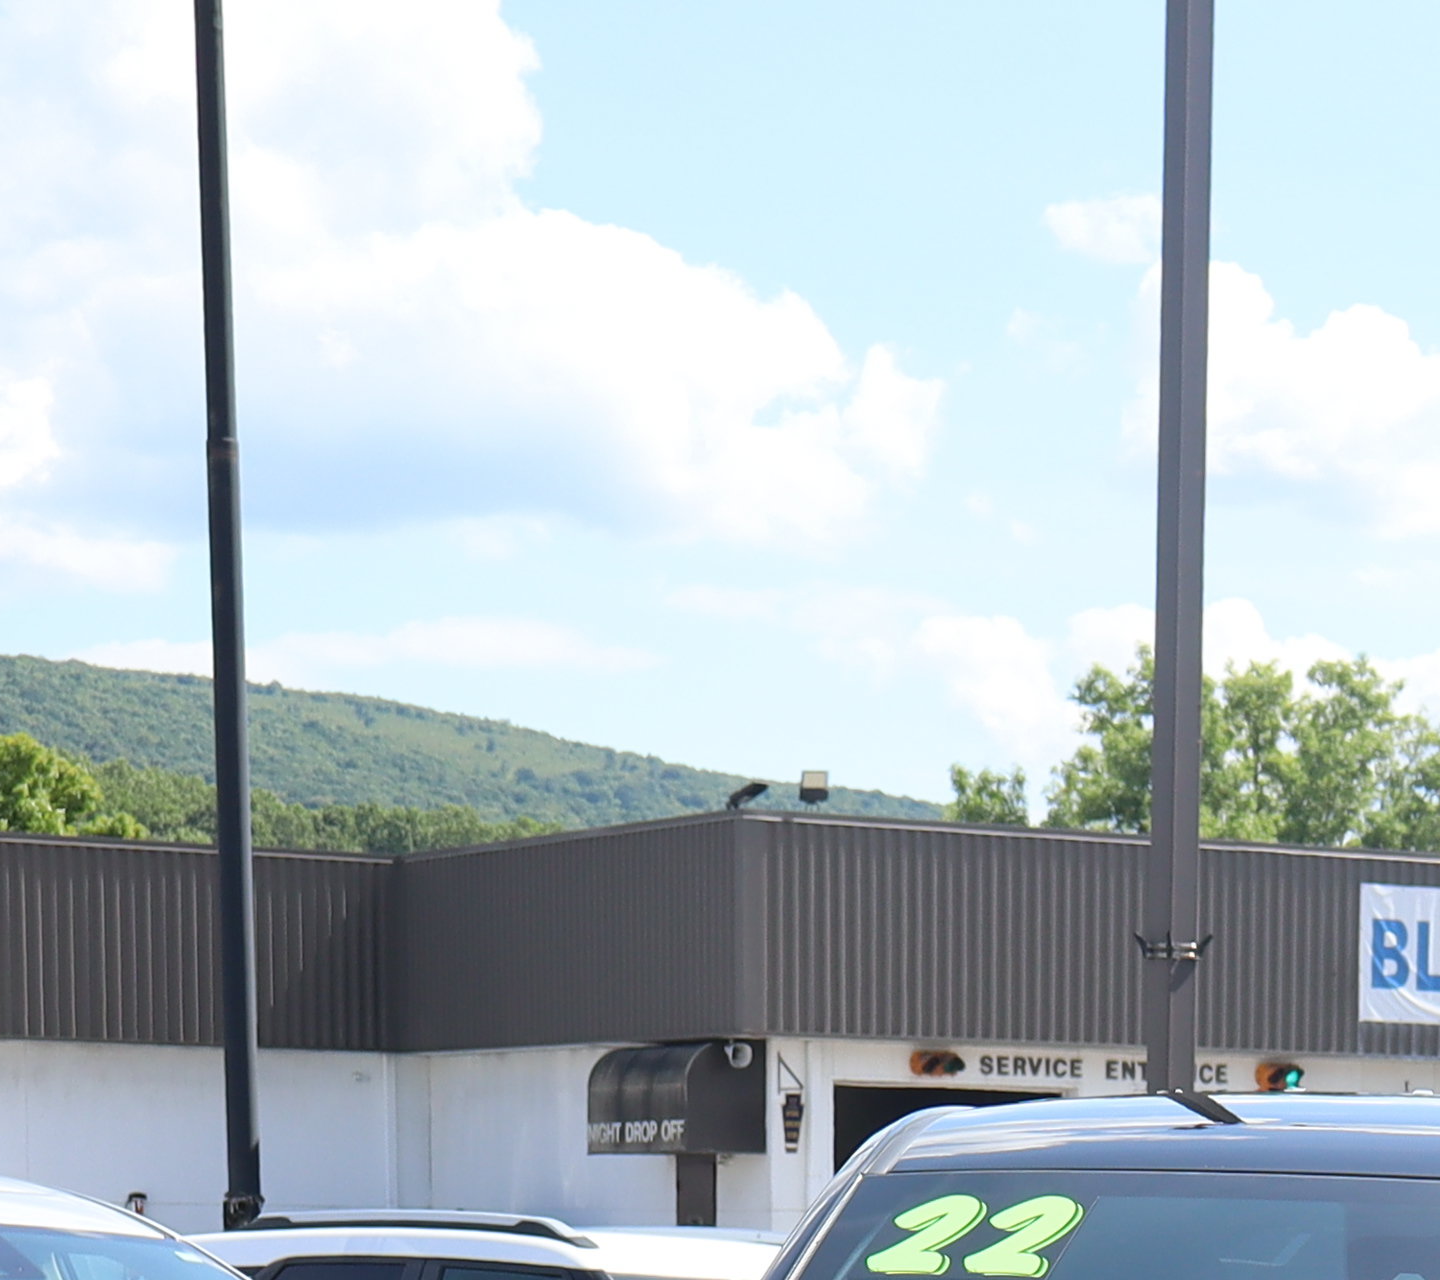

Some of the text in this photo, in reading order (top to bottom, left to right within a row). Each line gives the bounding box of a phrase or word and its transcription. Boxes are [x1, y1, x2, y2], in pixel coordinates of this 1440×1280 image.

[979, 1055, 1228, 1084] SERVICE ENTCE
[588, 1119, 685, 1144] NIGHT DROP OFF
[865, 1194, 1085, 1278] 22
